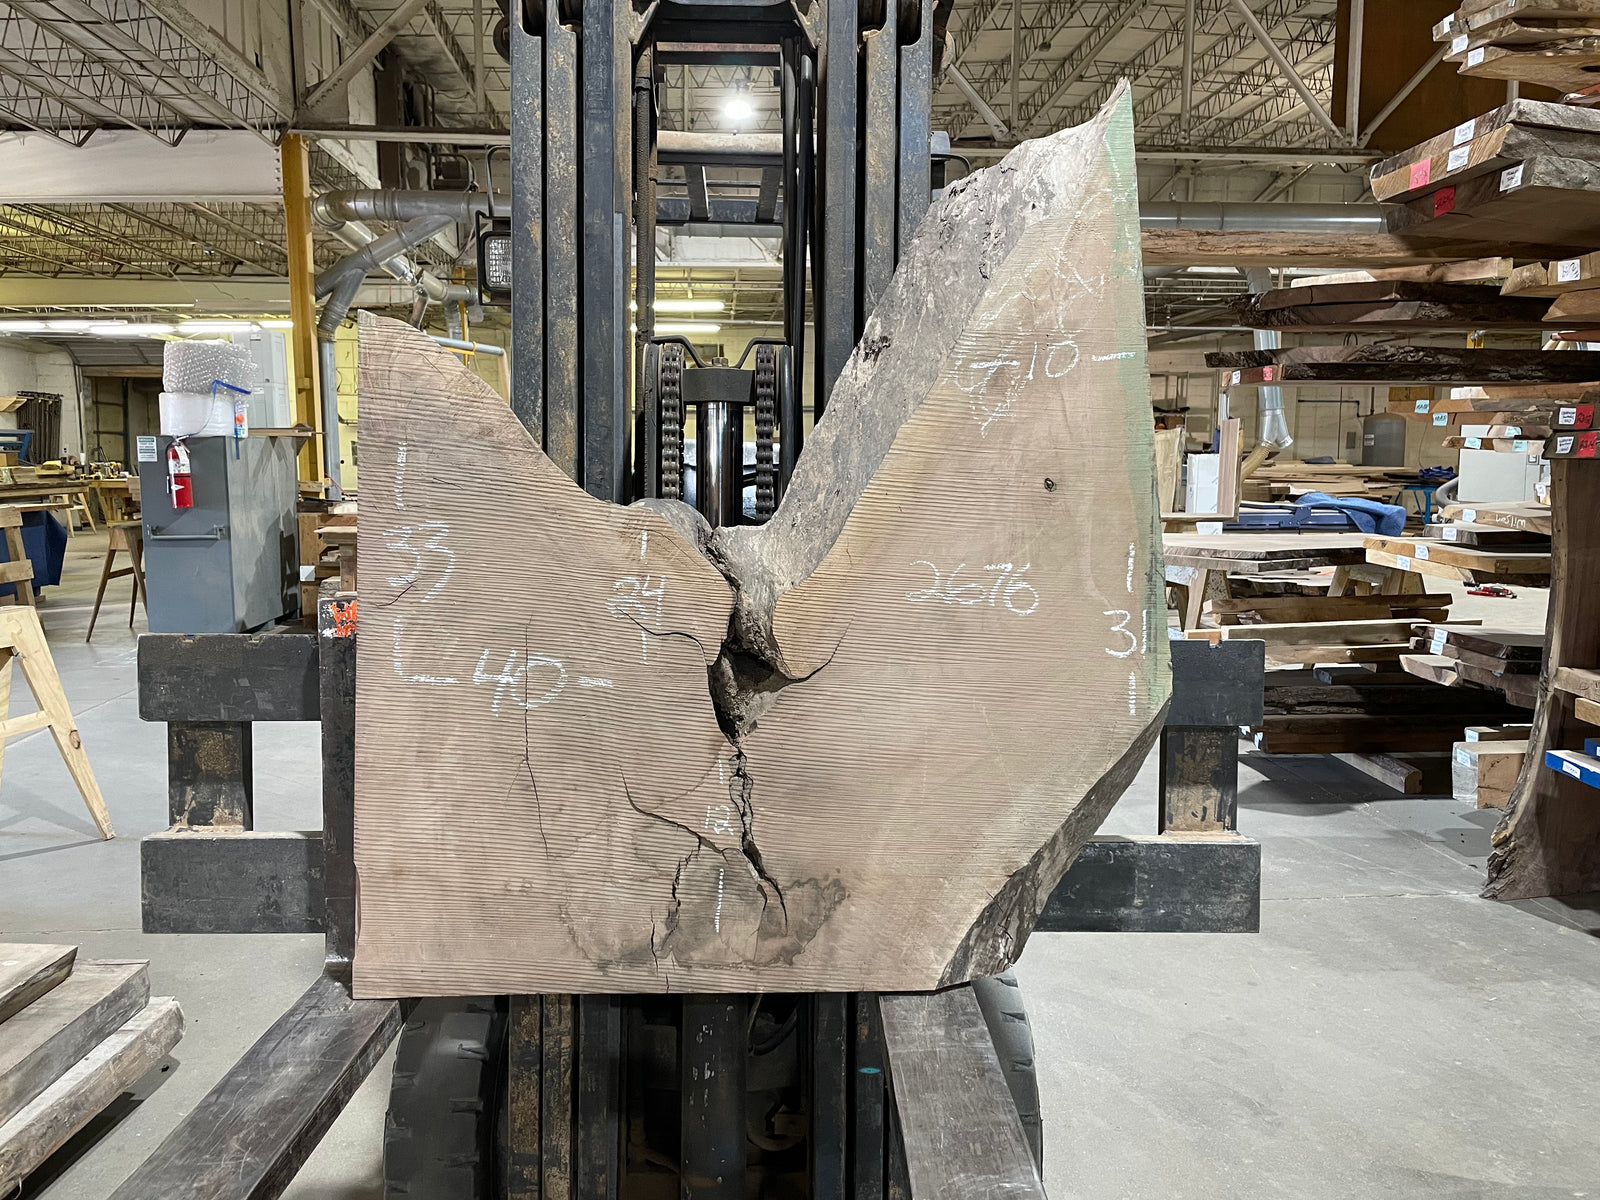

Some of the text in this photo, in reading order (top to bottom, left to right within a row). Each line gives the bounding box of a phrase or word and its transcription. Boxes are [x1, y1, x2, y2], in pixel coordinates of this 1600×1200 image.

[604, 574, 667, 627] 24
[905, 560, 1040, 616] 2676
[1102, 608, 1148, 659] 31
[472, 648, 568, 718] 40
